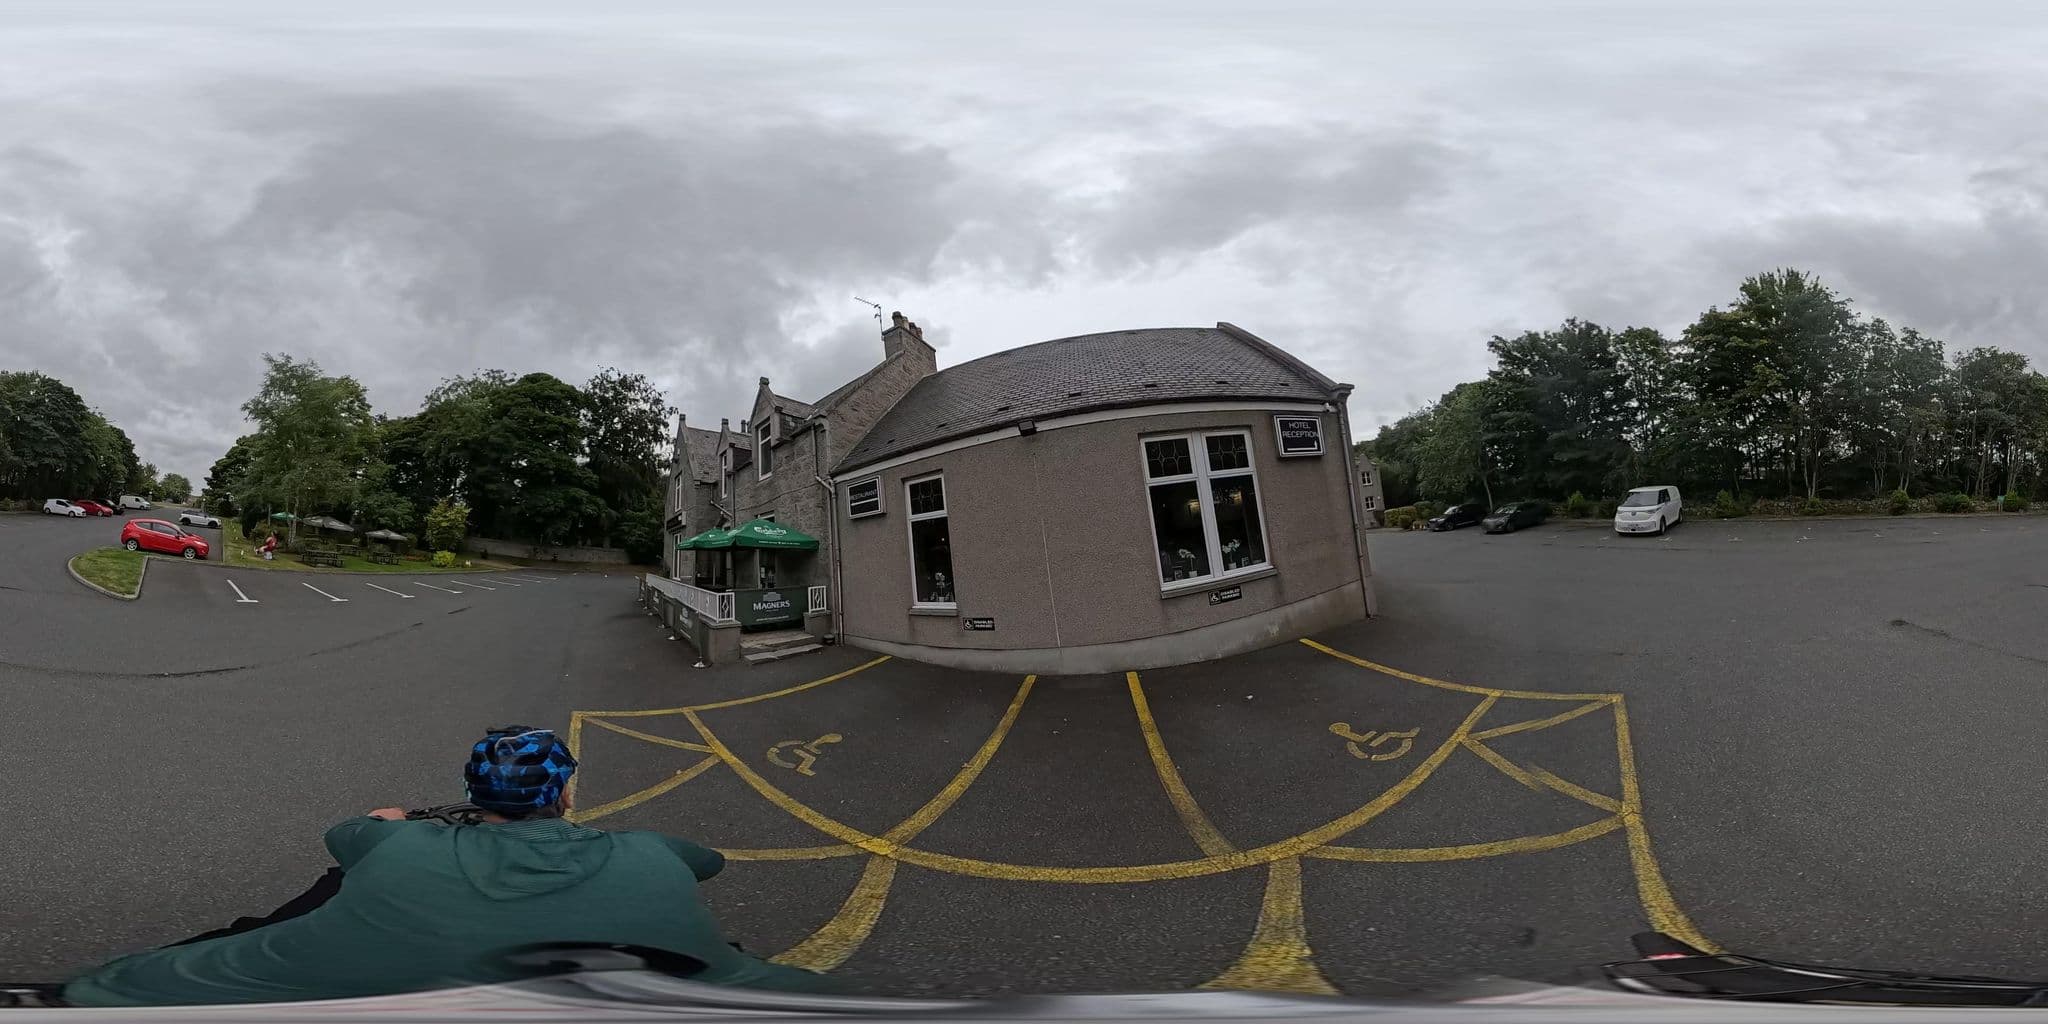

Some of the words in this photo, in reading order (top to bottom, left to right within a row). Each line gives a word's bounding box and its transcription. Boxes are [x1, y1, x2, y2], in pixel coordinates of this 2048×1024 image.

[1289, 421, 1310, 429] HOTEL
[1282, 430, 1320, 438] RECEPTION
[753, 600, 791, 610] MAGNERS
